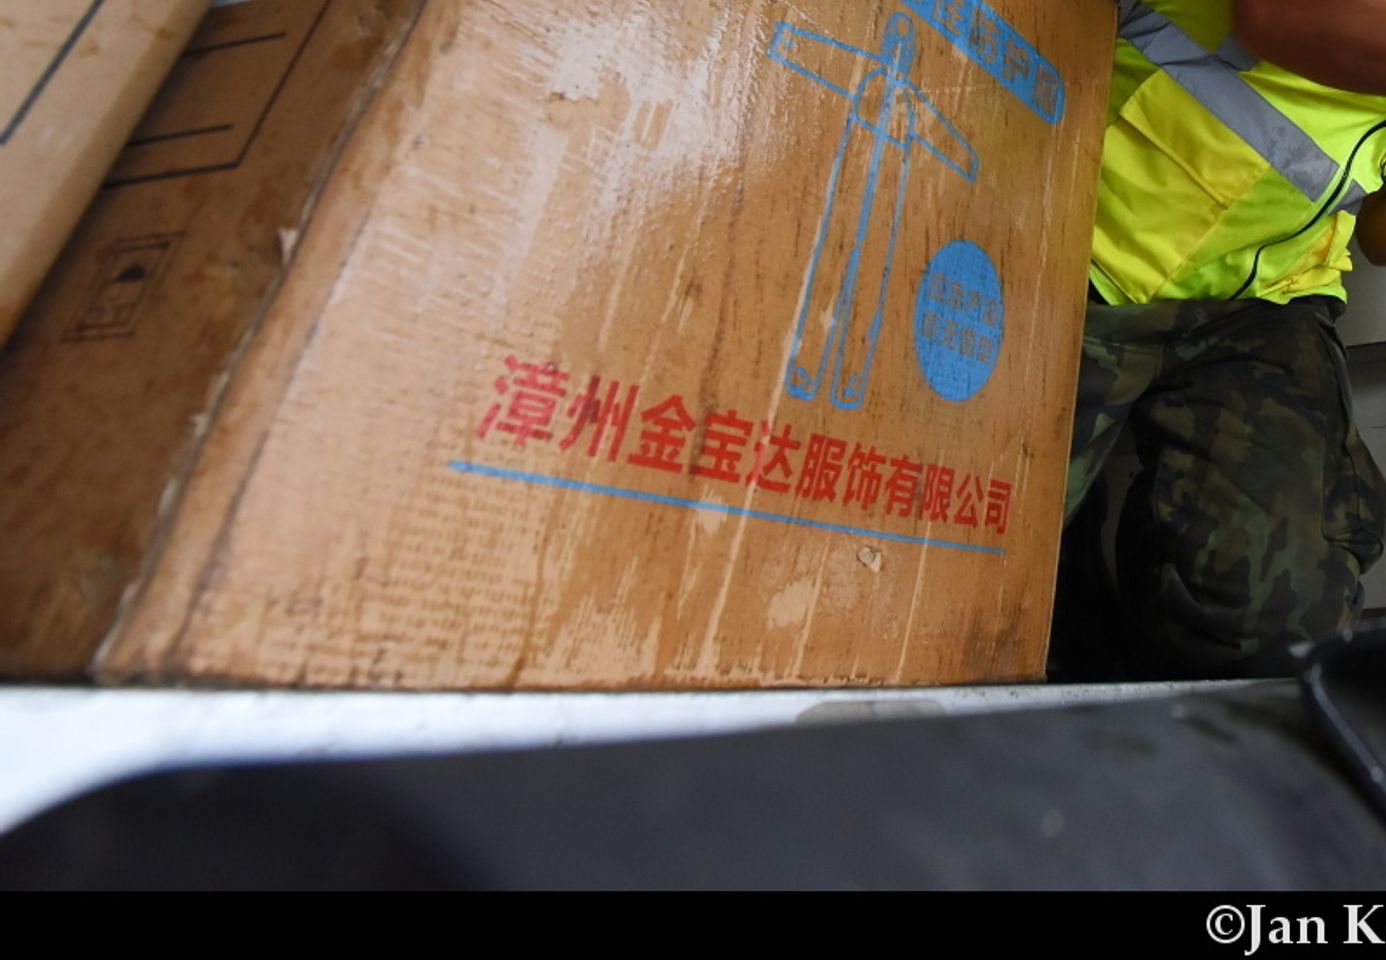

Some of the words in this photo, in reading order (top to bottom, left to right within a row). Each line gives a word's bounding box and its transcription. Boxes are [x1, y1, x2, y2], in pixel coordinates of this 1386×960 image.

[474, 354, 1014, 535] 漳州金宝达服饰有限公司
